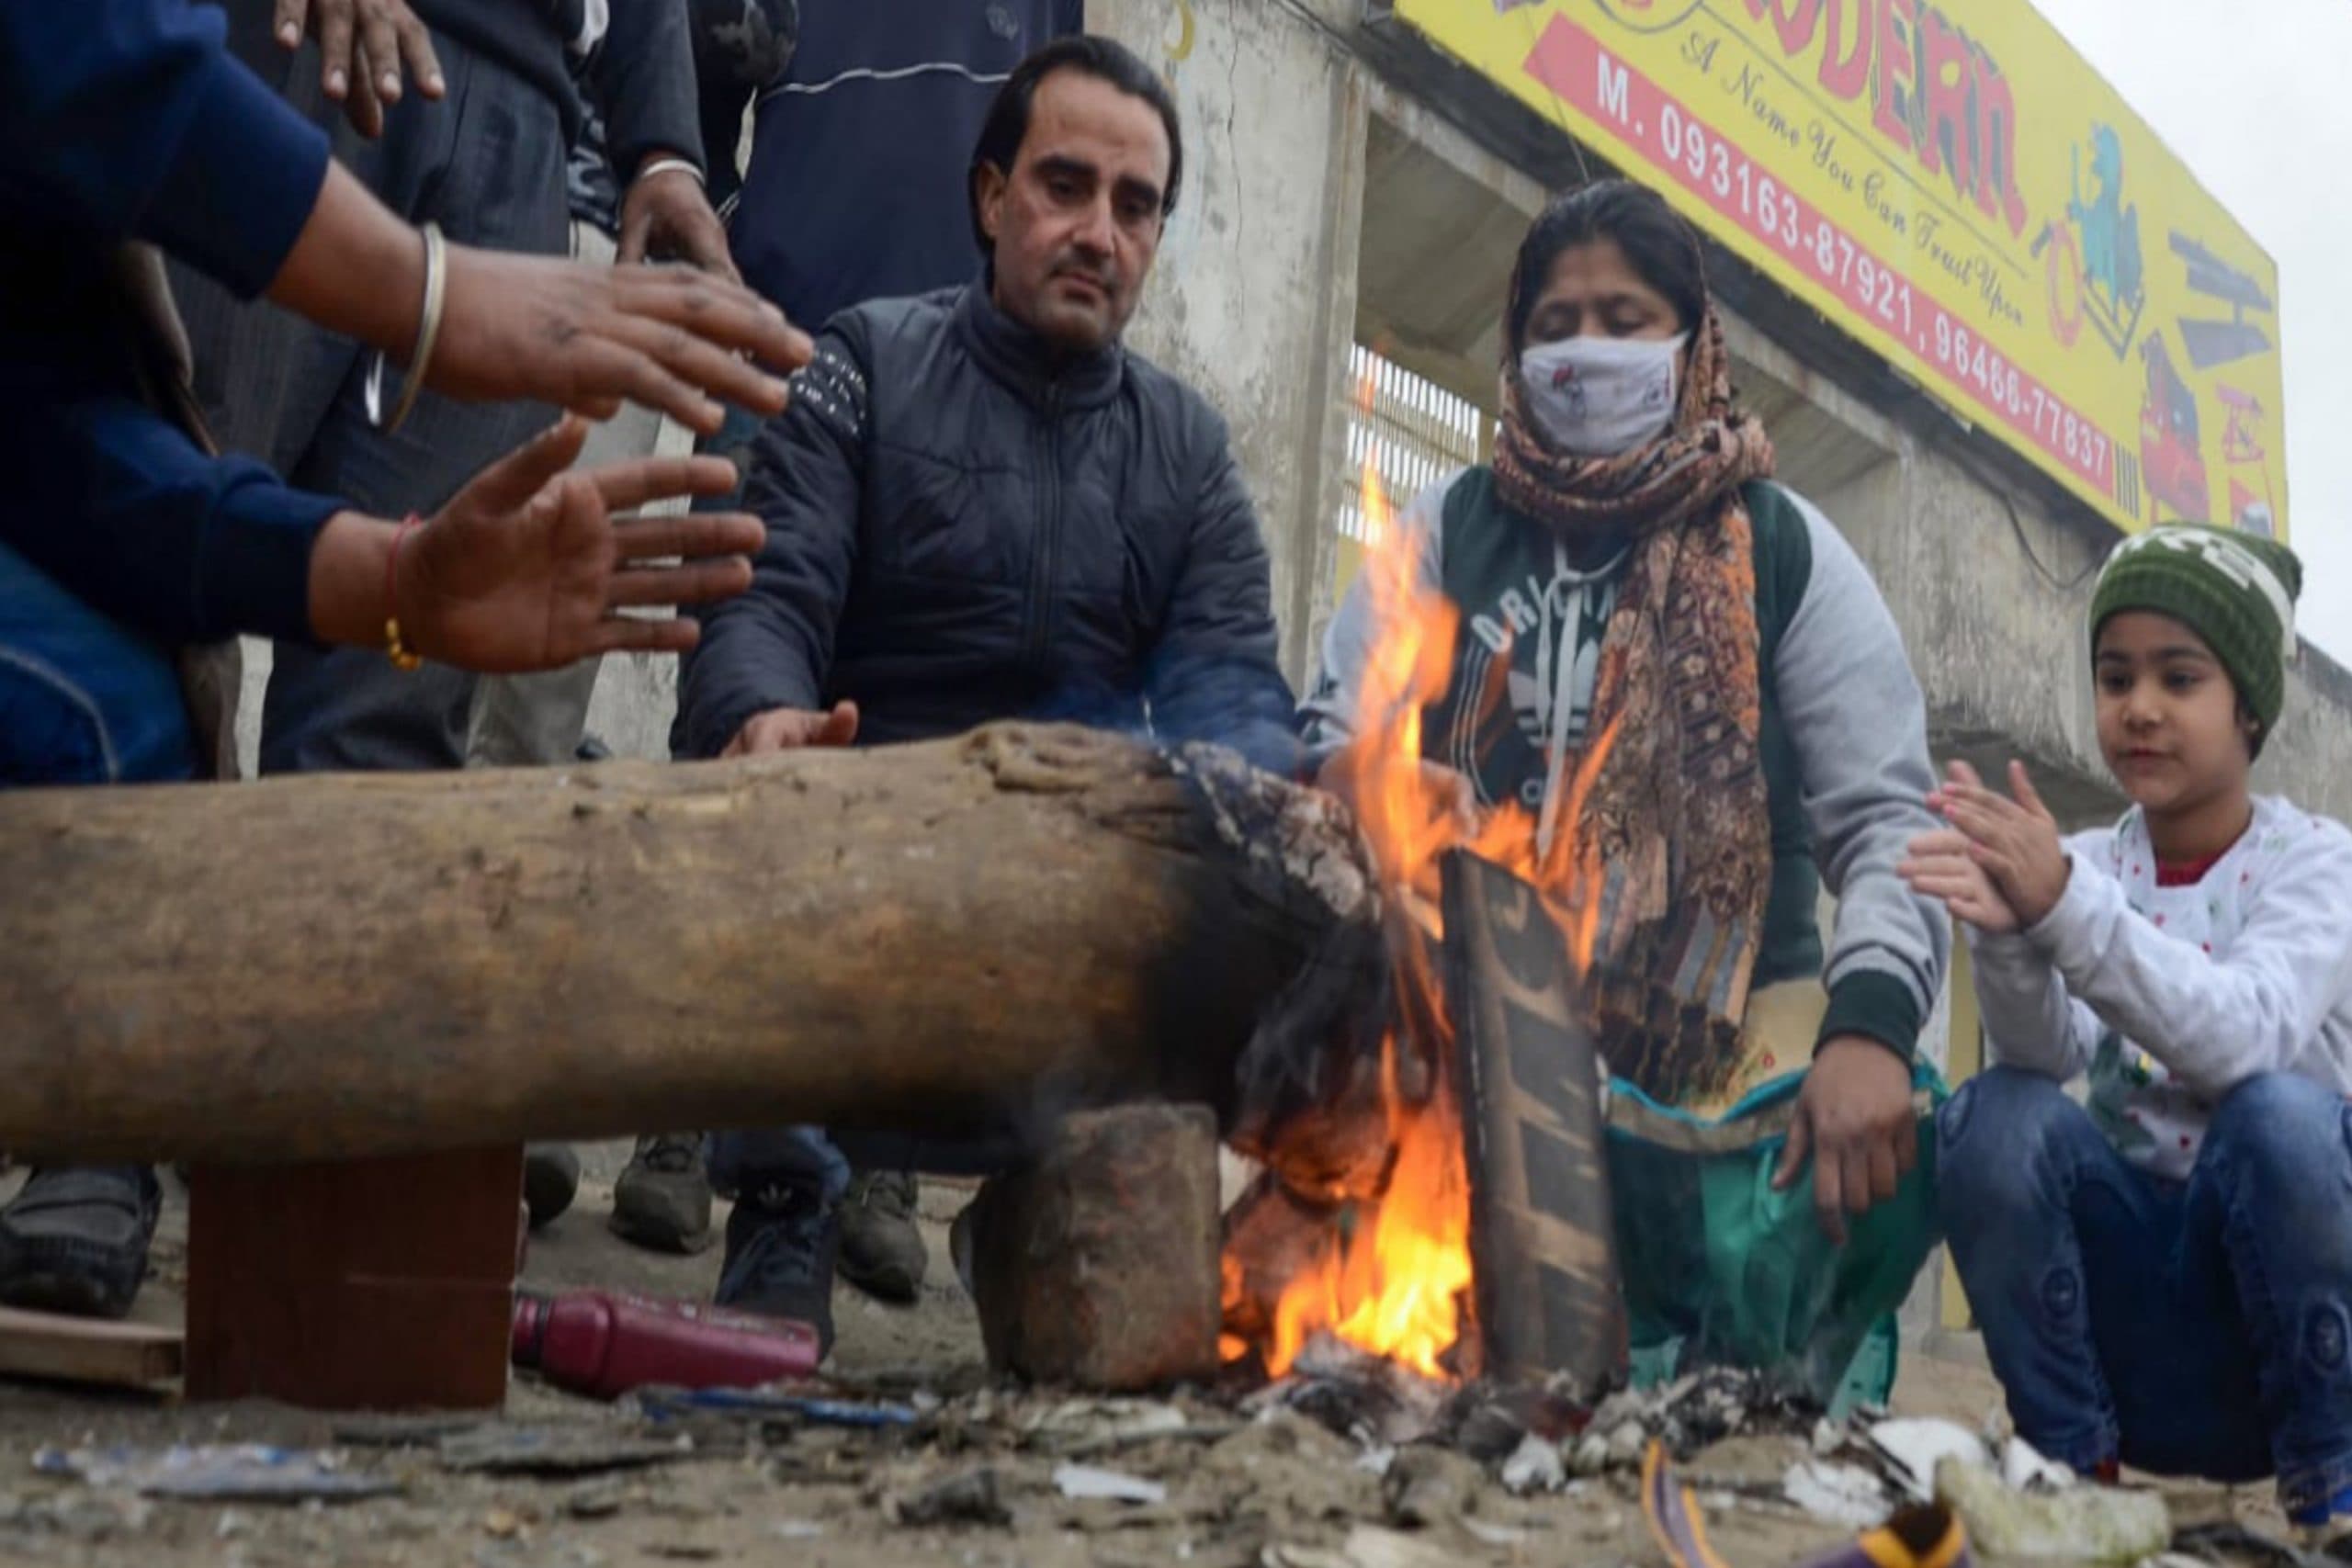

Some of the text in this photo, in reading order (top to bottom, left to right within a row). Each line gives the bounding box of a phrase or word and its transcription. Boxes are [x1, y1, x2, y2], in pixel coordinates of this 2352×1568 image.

[1596, 51, 1645, 138] M.
[1680, 31, 1720, 74] A
[1721, 61, 1801, 147] Name
[1806, 118, 1854, 192] You
[1863, 169, 1906, 234] Can
[1914, 210, 1973, 288] Trust
[1744, 0, 2028, 240] DERN
